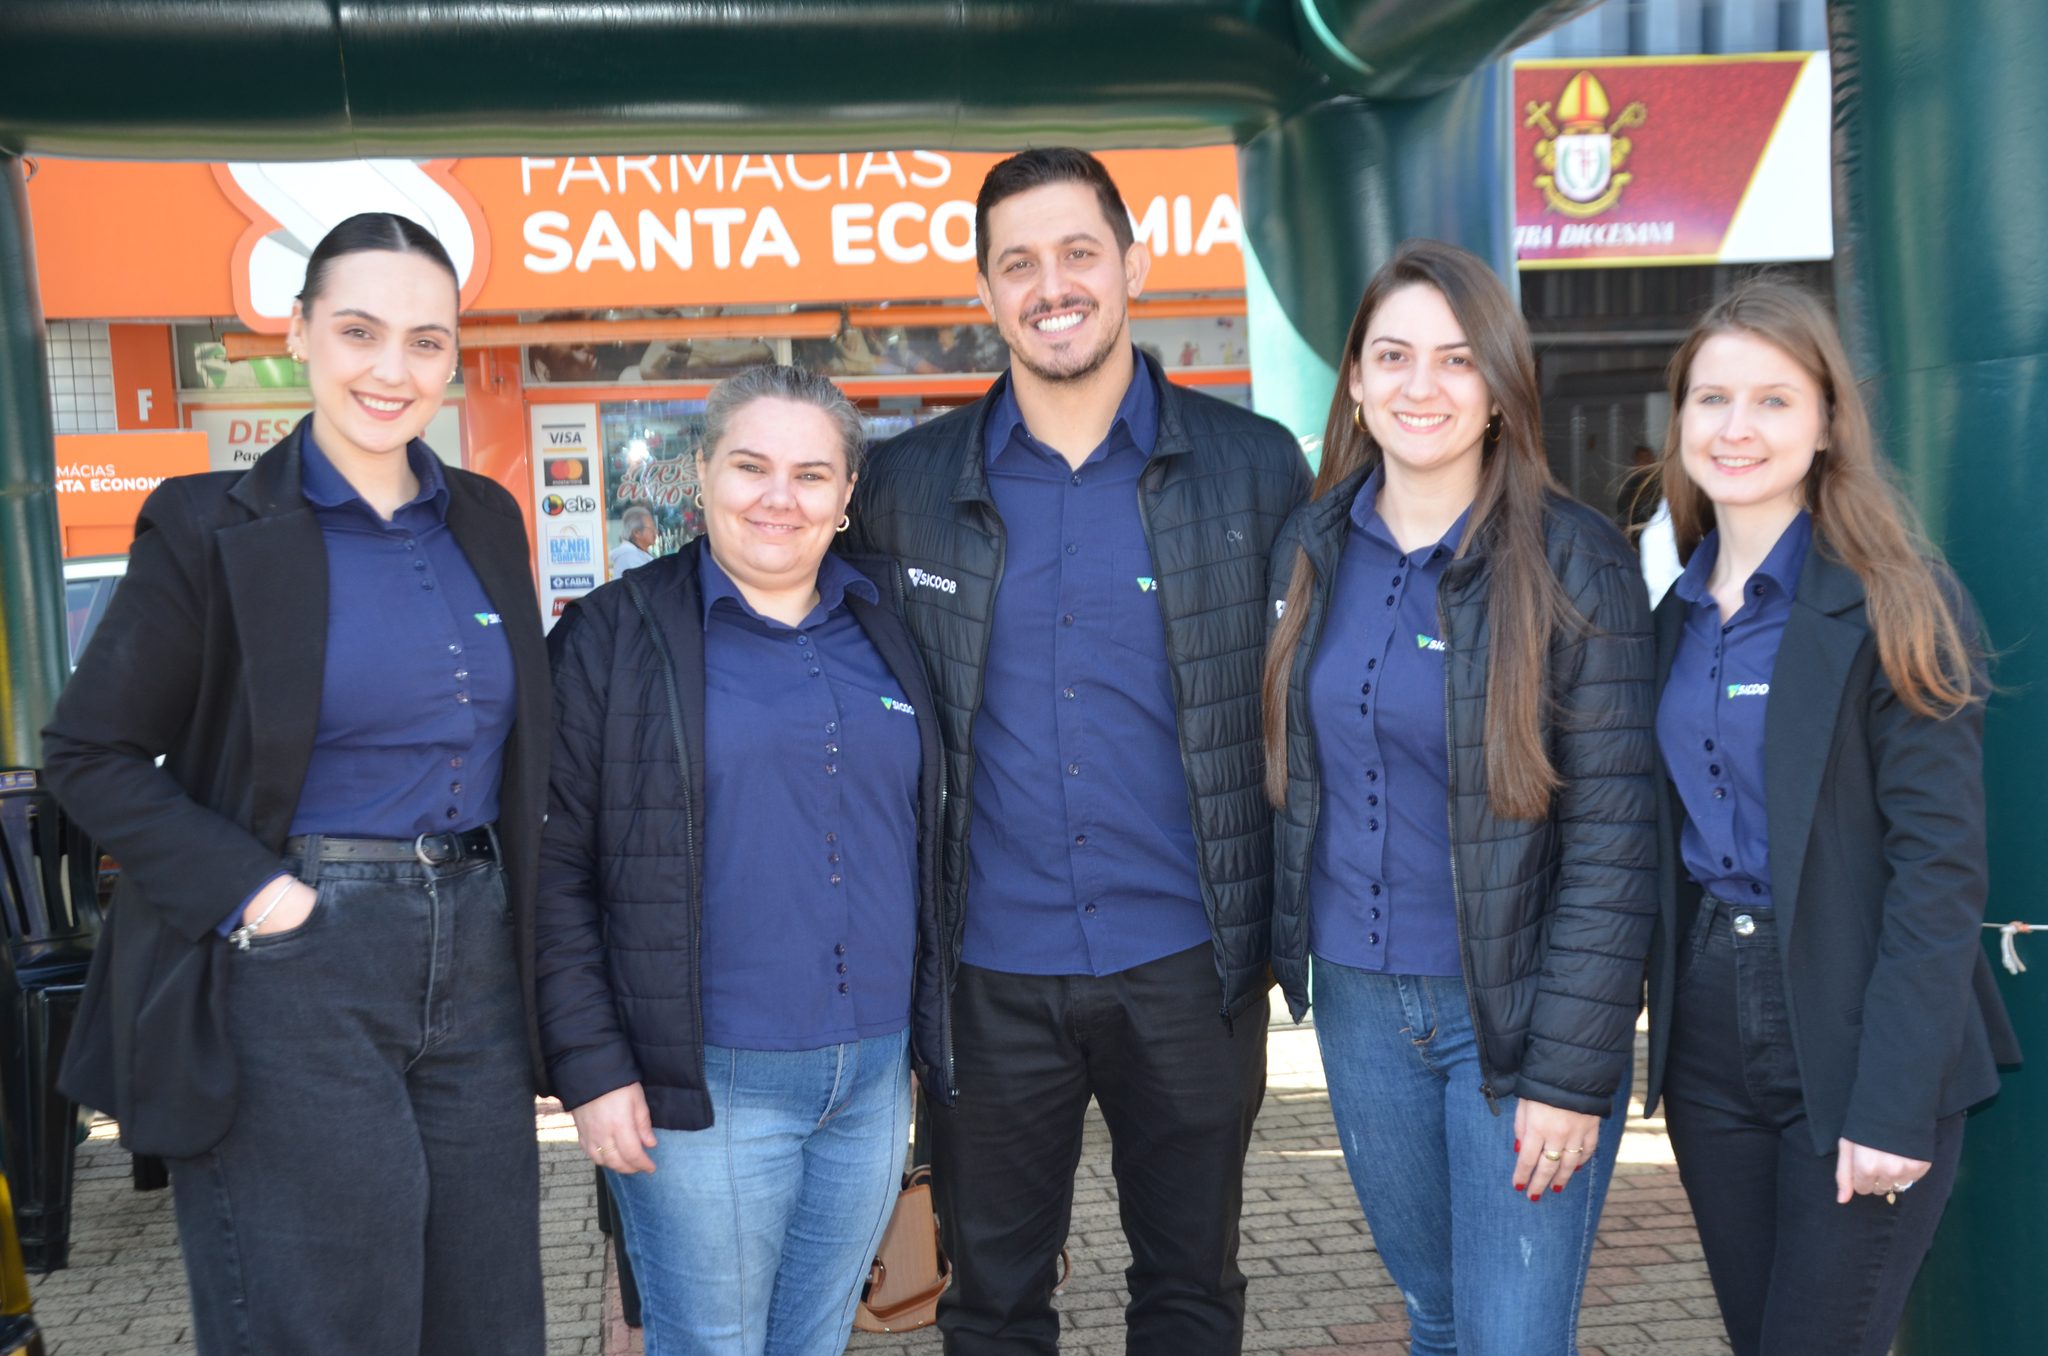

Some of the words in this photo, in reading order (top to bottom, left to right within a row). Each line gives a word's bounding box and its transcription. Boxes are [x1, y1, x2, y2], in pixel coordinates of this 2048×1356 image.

[522, 205, 801, 273] SANTA
[830, 193, 1244, 265] ECOMIA
[549, 431, 582, 445] VISA
[56, 462, 116, 478] MÁCIAS
[56, 478, 86, 493] NTA
[90, 476, 165, 493] ECONOM
[565, 494, 596, 513] elo
[564, 576, 592, 586] CABAL
[919, 572, 957, 594] SICOOB
[1736, 683, 1769, 696] SICOO
